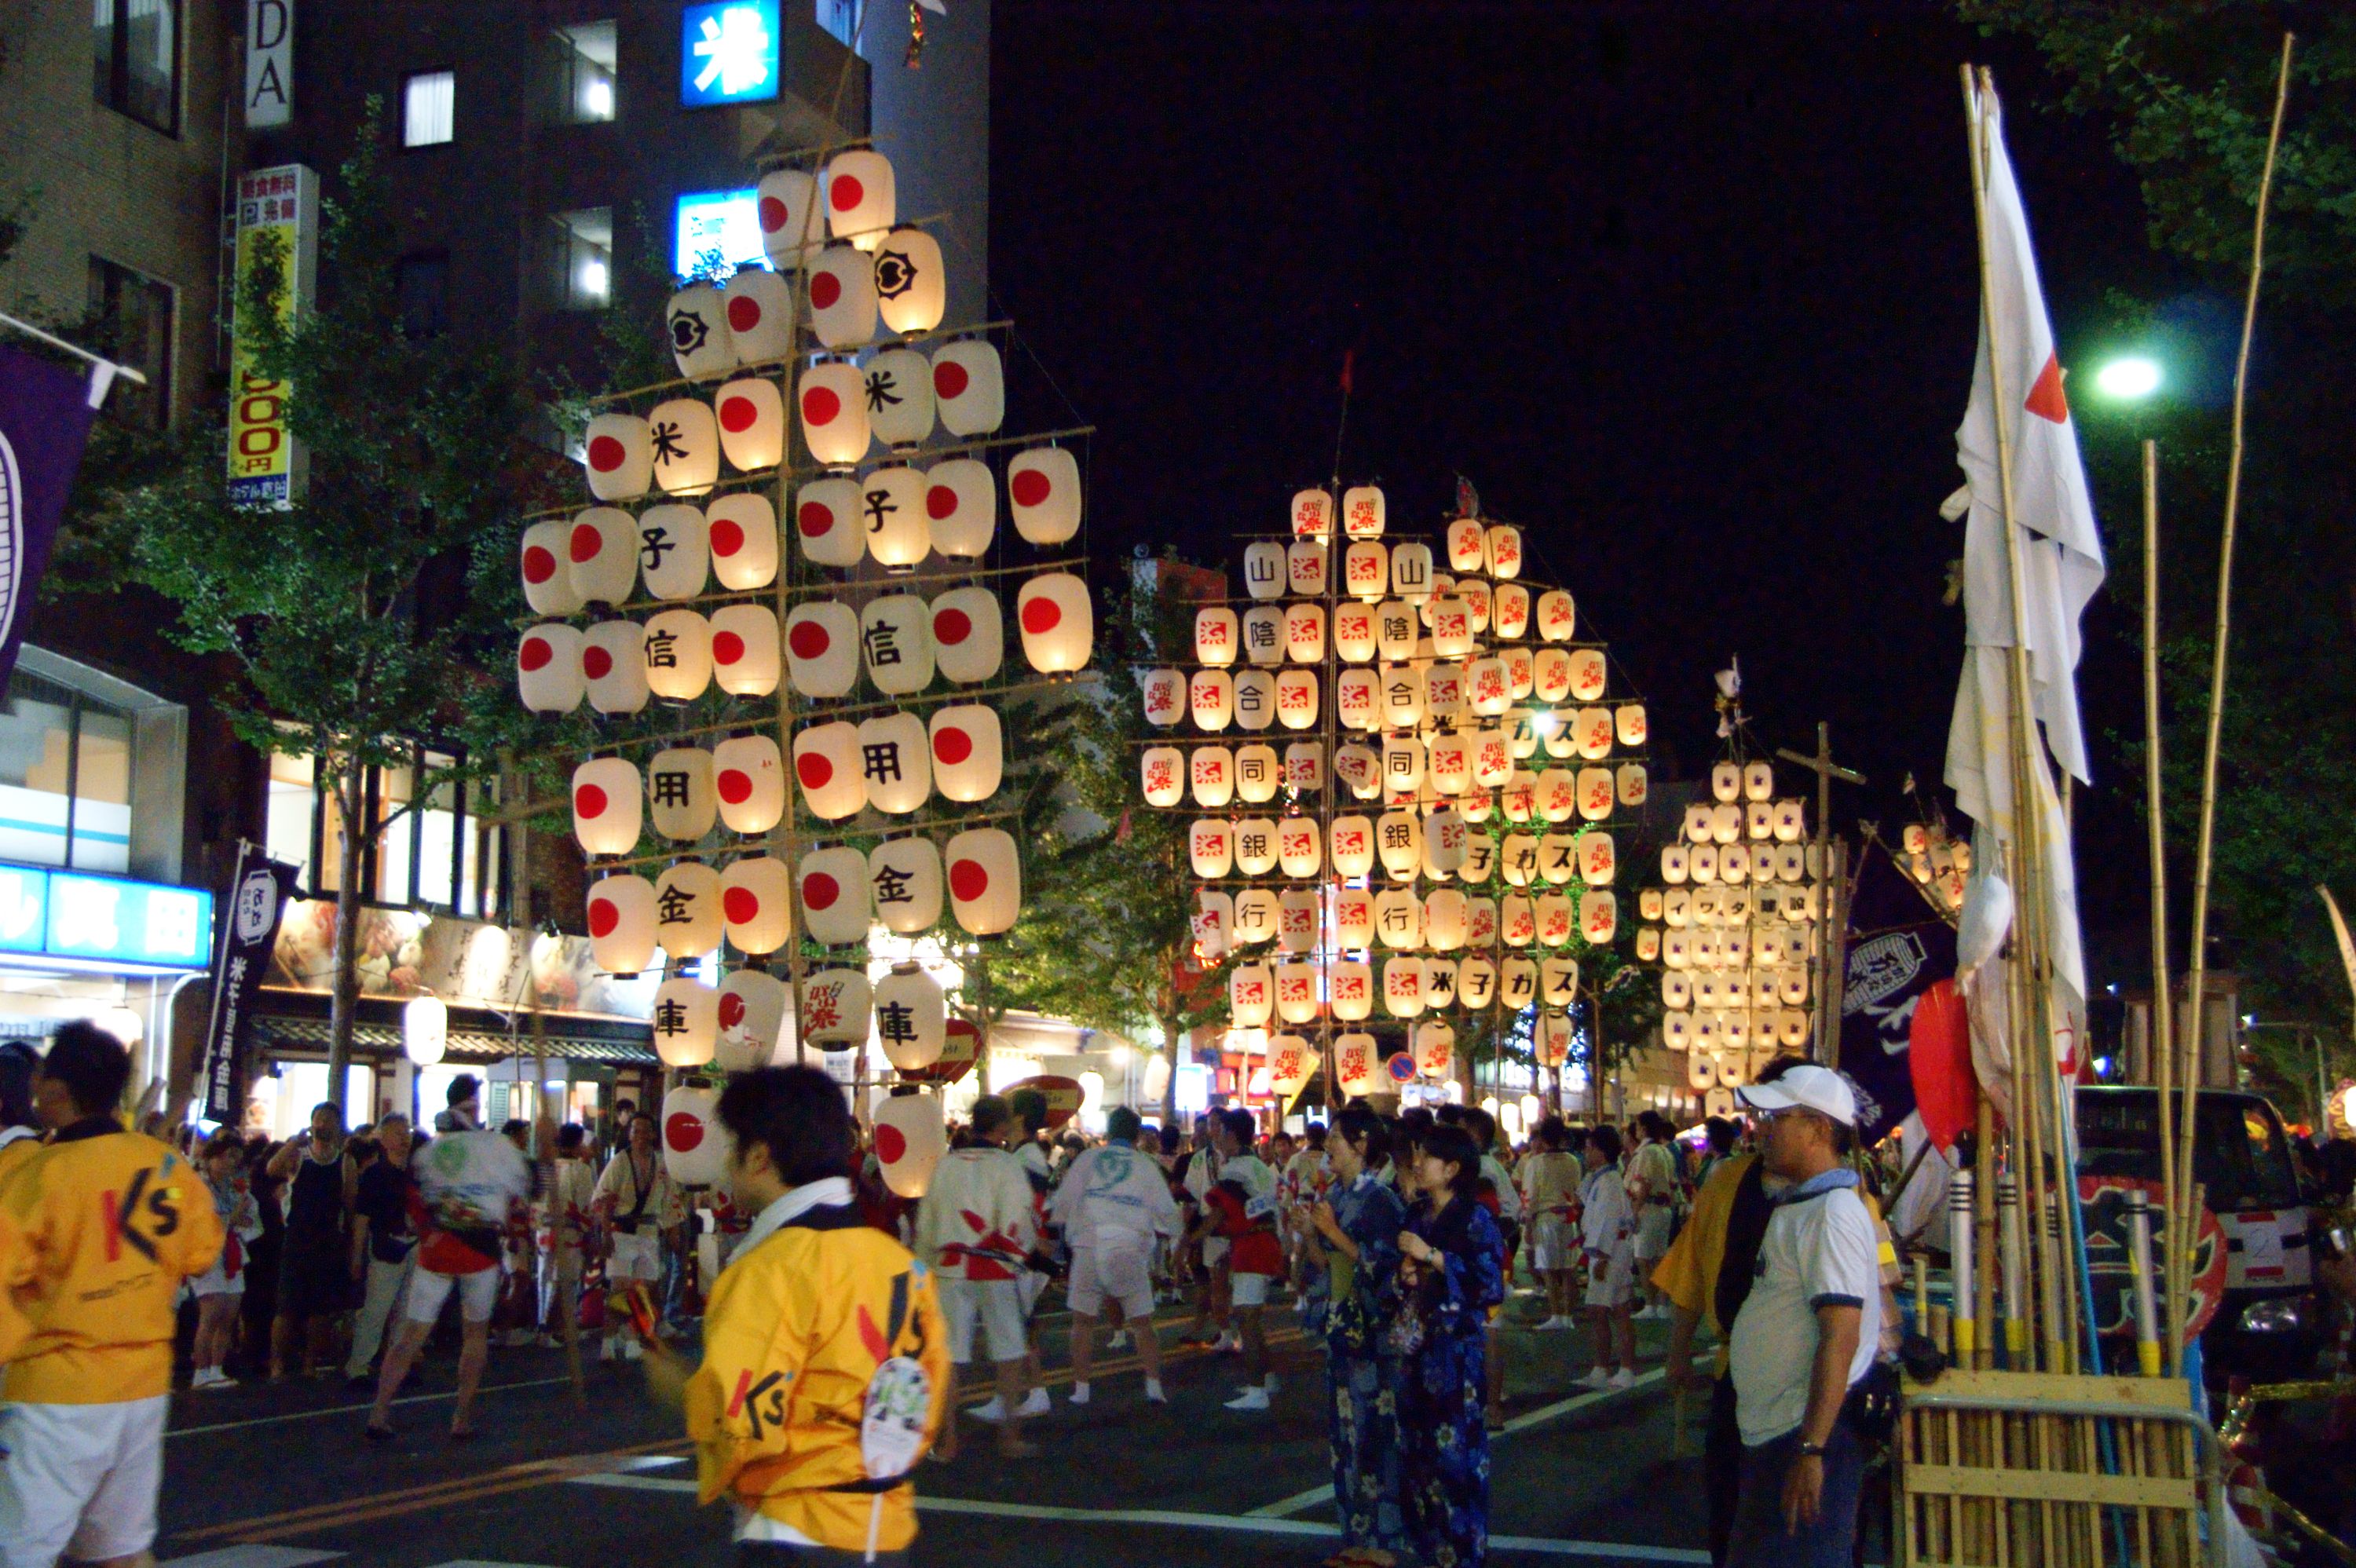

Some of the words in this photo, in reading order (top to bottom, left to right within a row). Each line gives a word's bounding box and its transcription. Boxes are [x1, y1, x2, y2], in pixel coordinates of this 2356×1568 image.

[866, 371, 902, 412] 米
[652, 422, 690, 466] 米
[865, 490, 897, 532] 子
[641, 527, 676, 570] 子
[1251, 557, 1274, 581] 山
[1400, 559, 1424, 584] 山
[1250, 621, 1275, 649] 陰
[1385, 617, 1408, 640] 陰
[645, 630, 676, 667] 信
[864, 620, 901, 667] 信
[1239, 685, 1263, 711] 合
[1389, 682, 1413, 705] 合
[1557, 721, 1573, 741] ス
[863, 742, 901, 784] 用
[1242, 759, 1264, 780] 同
[1389, 752, 1412, 774] 同
[654, 772, 689, 806] 用
[1242, 835, 1265, 857] 銀
[1385, 824, 1410, 847] 銀
[1472, 847, 1491, 870] 子
[1516, 849, 1535, 869] ガ
[1553, 847, 1571, 867] ス
[874, 865, 913, 902] 金
[657, 884, 696, 924] 金
[1242, 904, 1265, 926] 行
[1384, 908, 1407, 929] 行
[1432, 973, 1451, 991] 米
[1471, 974, 1491, 995] 子
[1513, 974, 1531, 993] ガ
[1555, 972, 1572, 991] ス
[654, 999, 689, 1037] 庫
[879, 1001, 917, 1045] 庫
